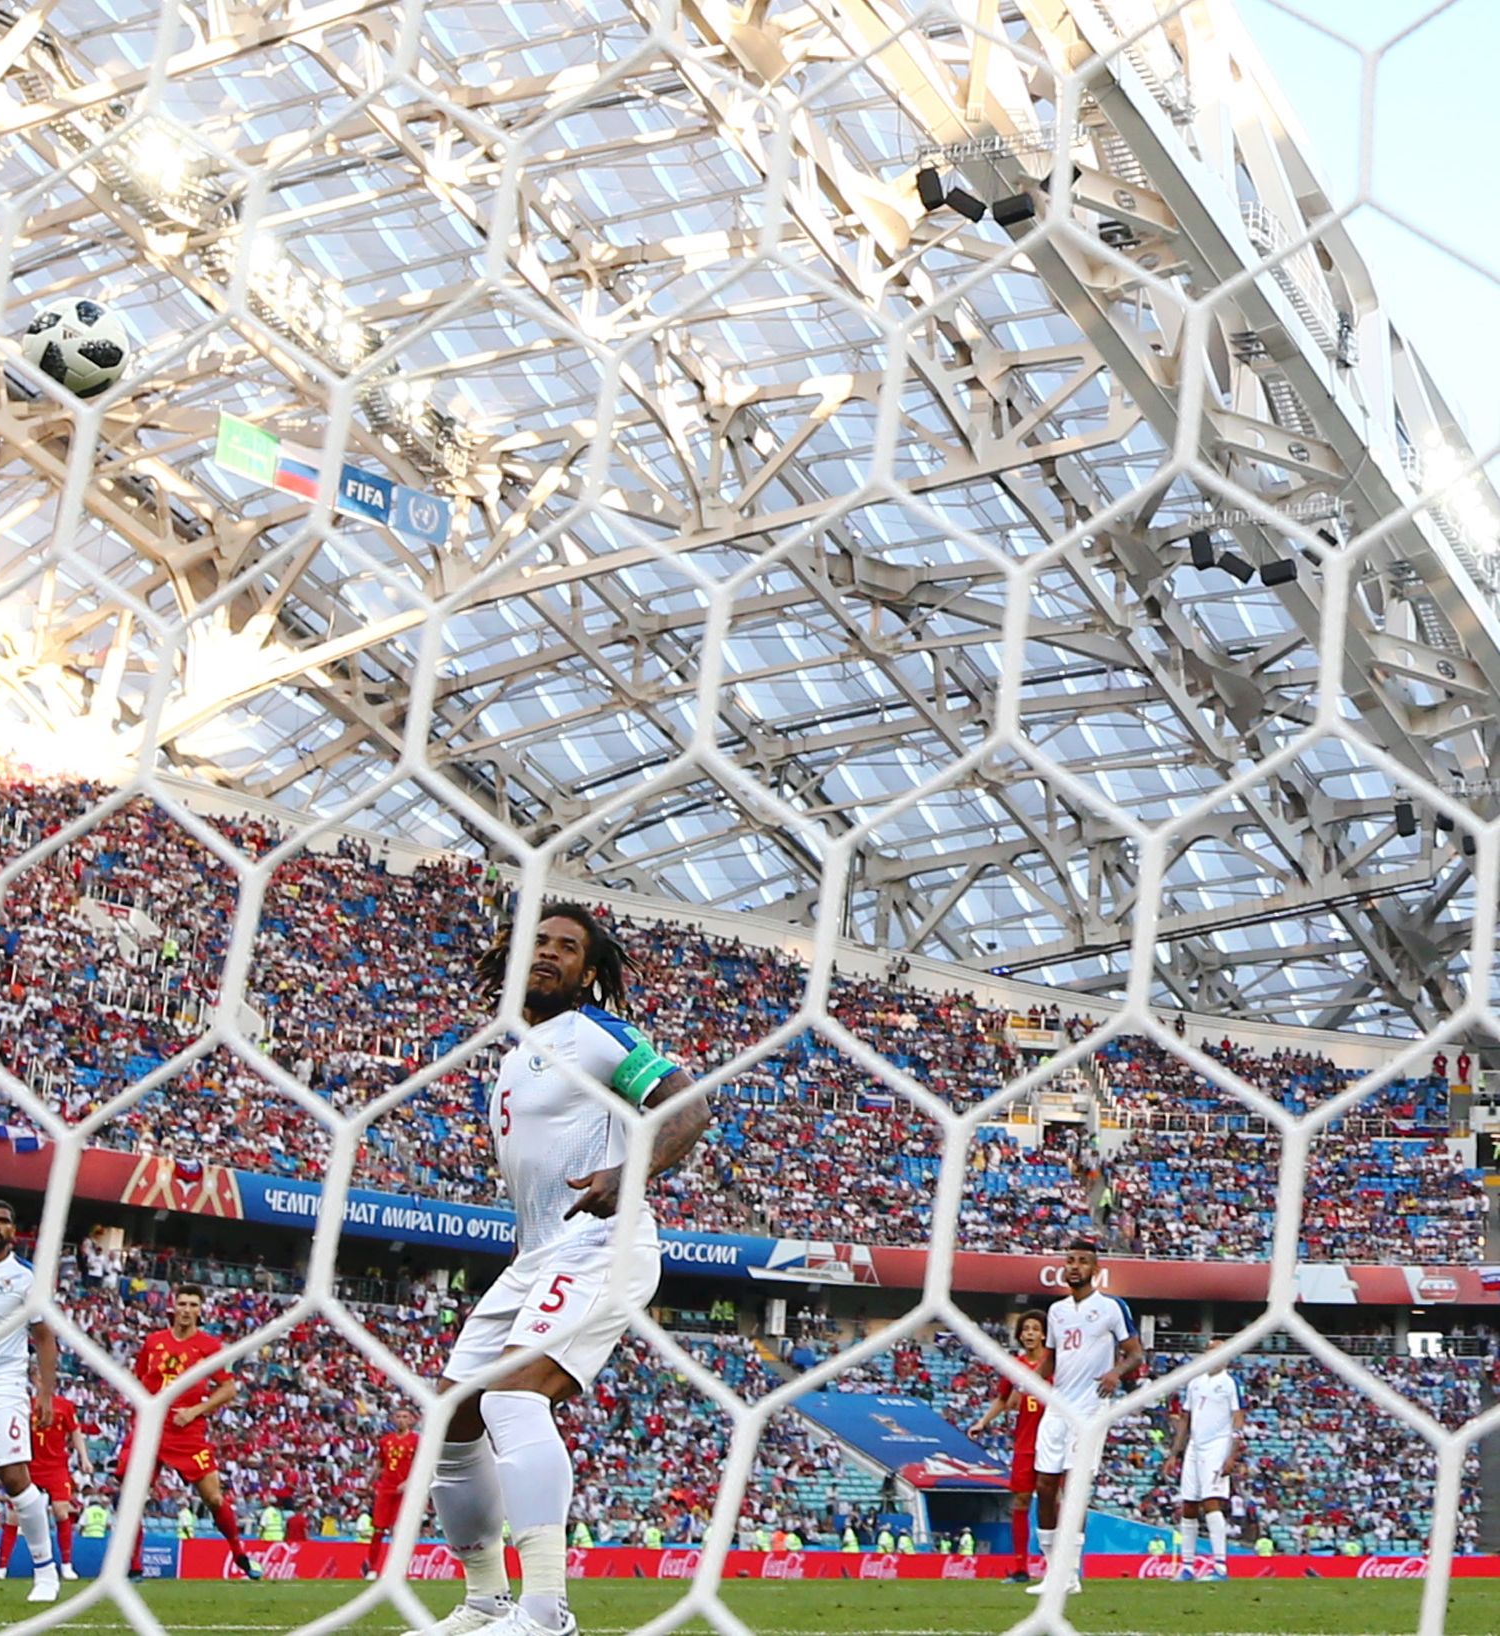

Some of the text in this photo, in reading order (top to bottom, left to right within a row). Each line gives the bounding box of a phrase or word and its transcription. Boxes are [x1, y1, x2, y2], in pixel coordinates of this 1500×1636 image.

[345, 479, 385, 510] FIFA
[264, 1188, 379, 1225] ЧЕМПНАТ
[381, 1206, 434, 1233] МИРА
[437, 1212, 463, 1236] ПО
[659, 1240, 738, 1265] РОССИИ
[539, 1275, 576, 1314] 5
[1063, 1329, 1082, 1350] 20
[1027, 1396, 1038, 1412] 6
[9, 1416, 21, 1440] 6
[36, 1432, 45, 1447] 7
[192, 1449, 211, 1471] 15
